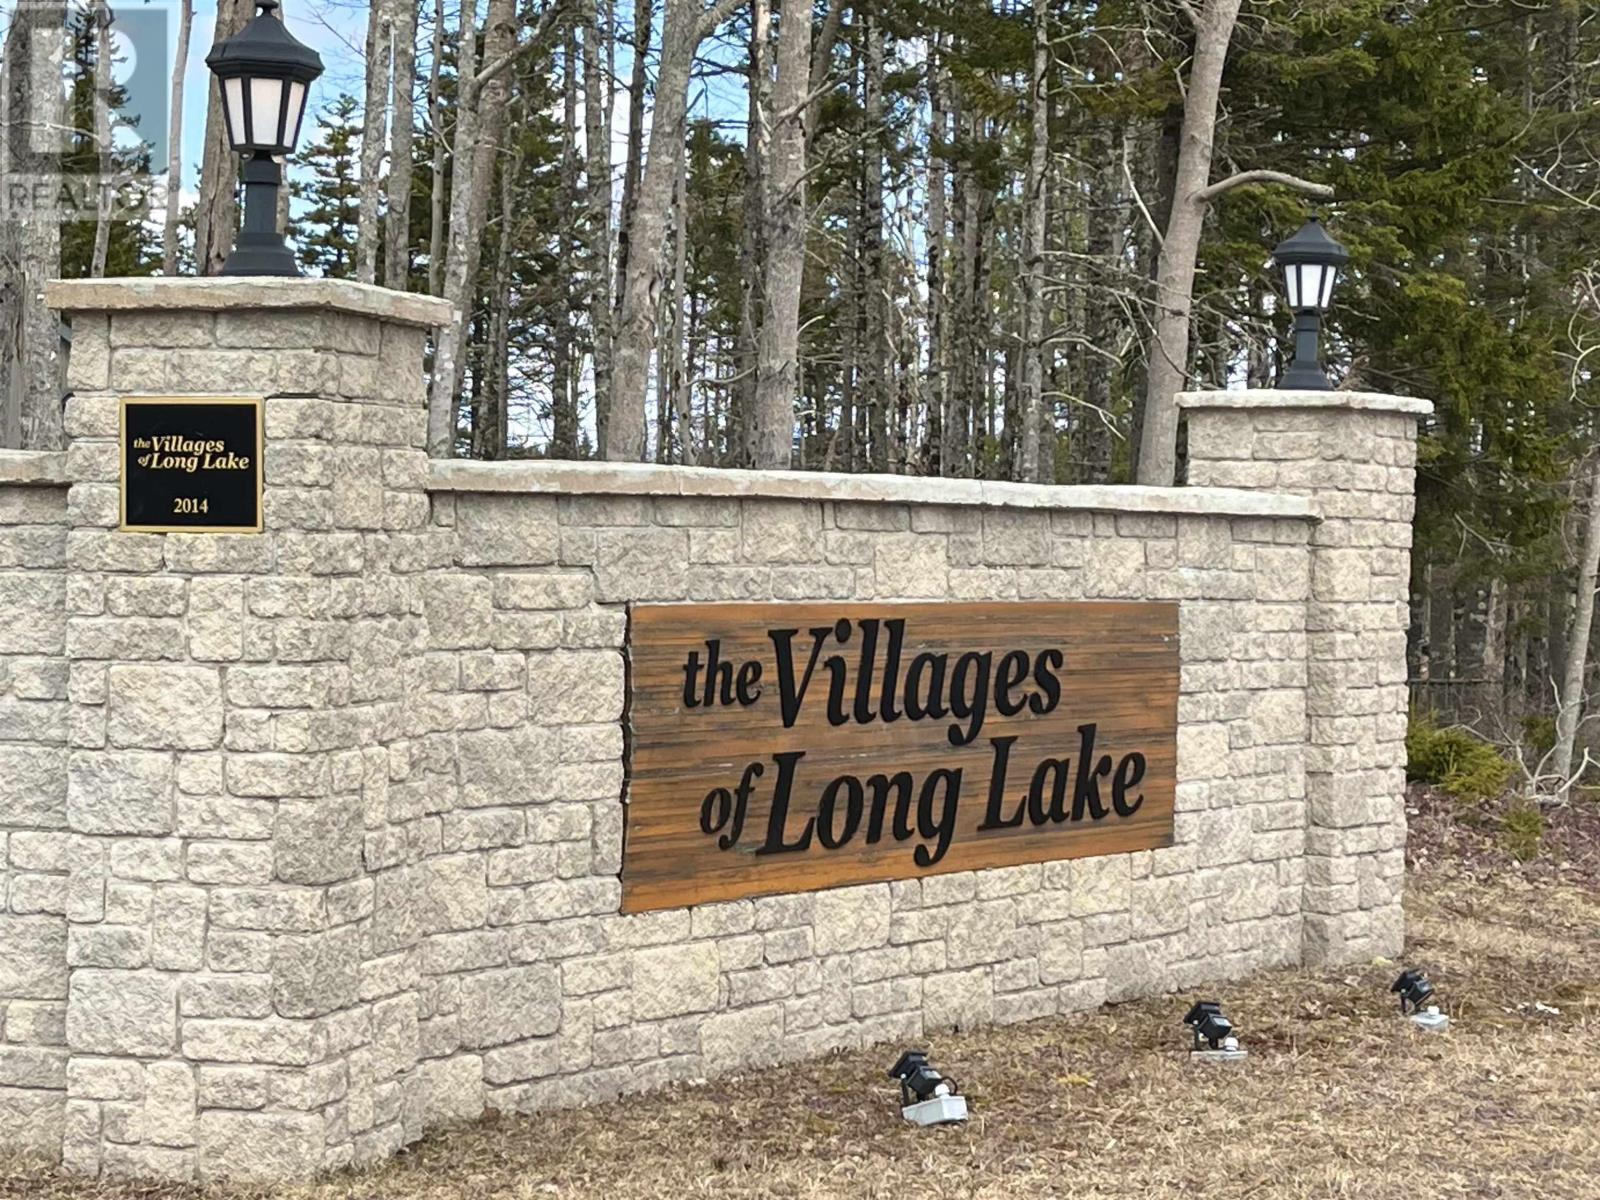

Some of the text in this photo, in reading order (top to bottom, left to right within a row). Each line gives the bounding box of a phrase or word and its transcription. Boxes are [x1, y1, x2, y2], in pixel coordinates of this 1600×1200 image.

[133, 435, 225, 455] the Villages
[137, 452, 250, 472] of Long Lake
[173, 498, 209, 513] 2014
[683, 618, 1065, 746] the Villages
[700, 723, 1148, 867] of Long Lake
